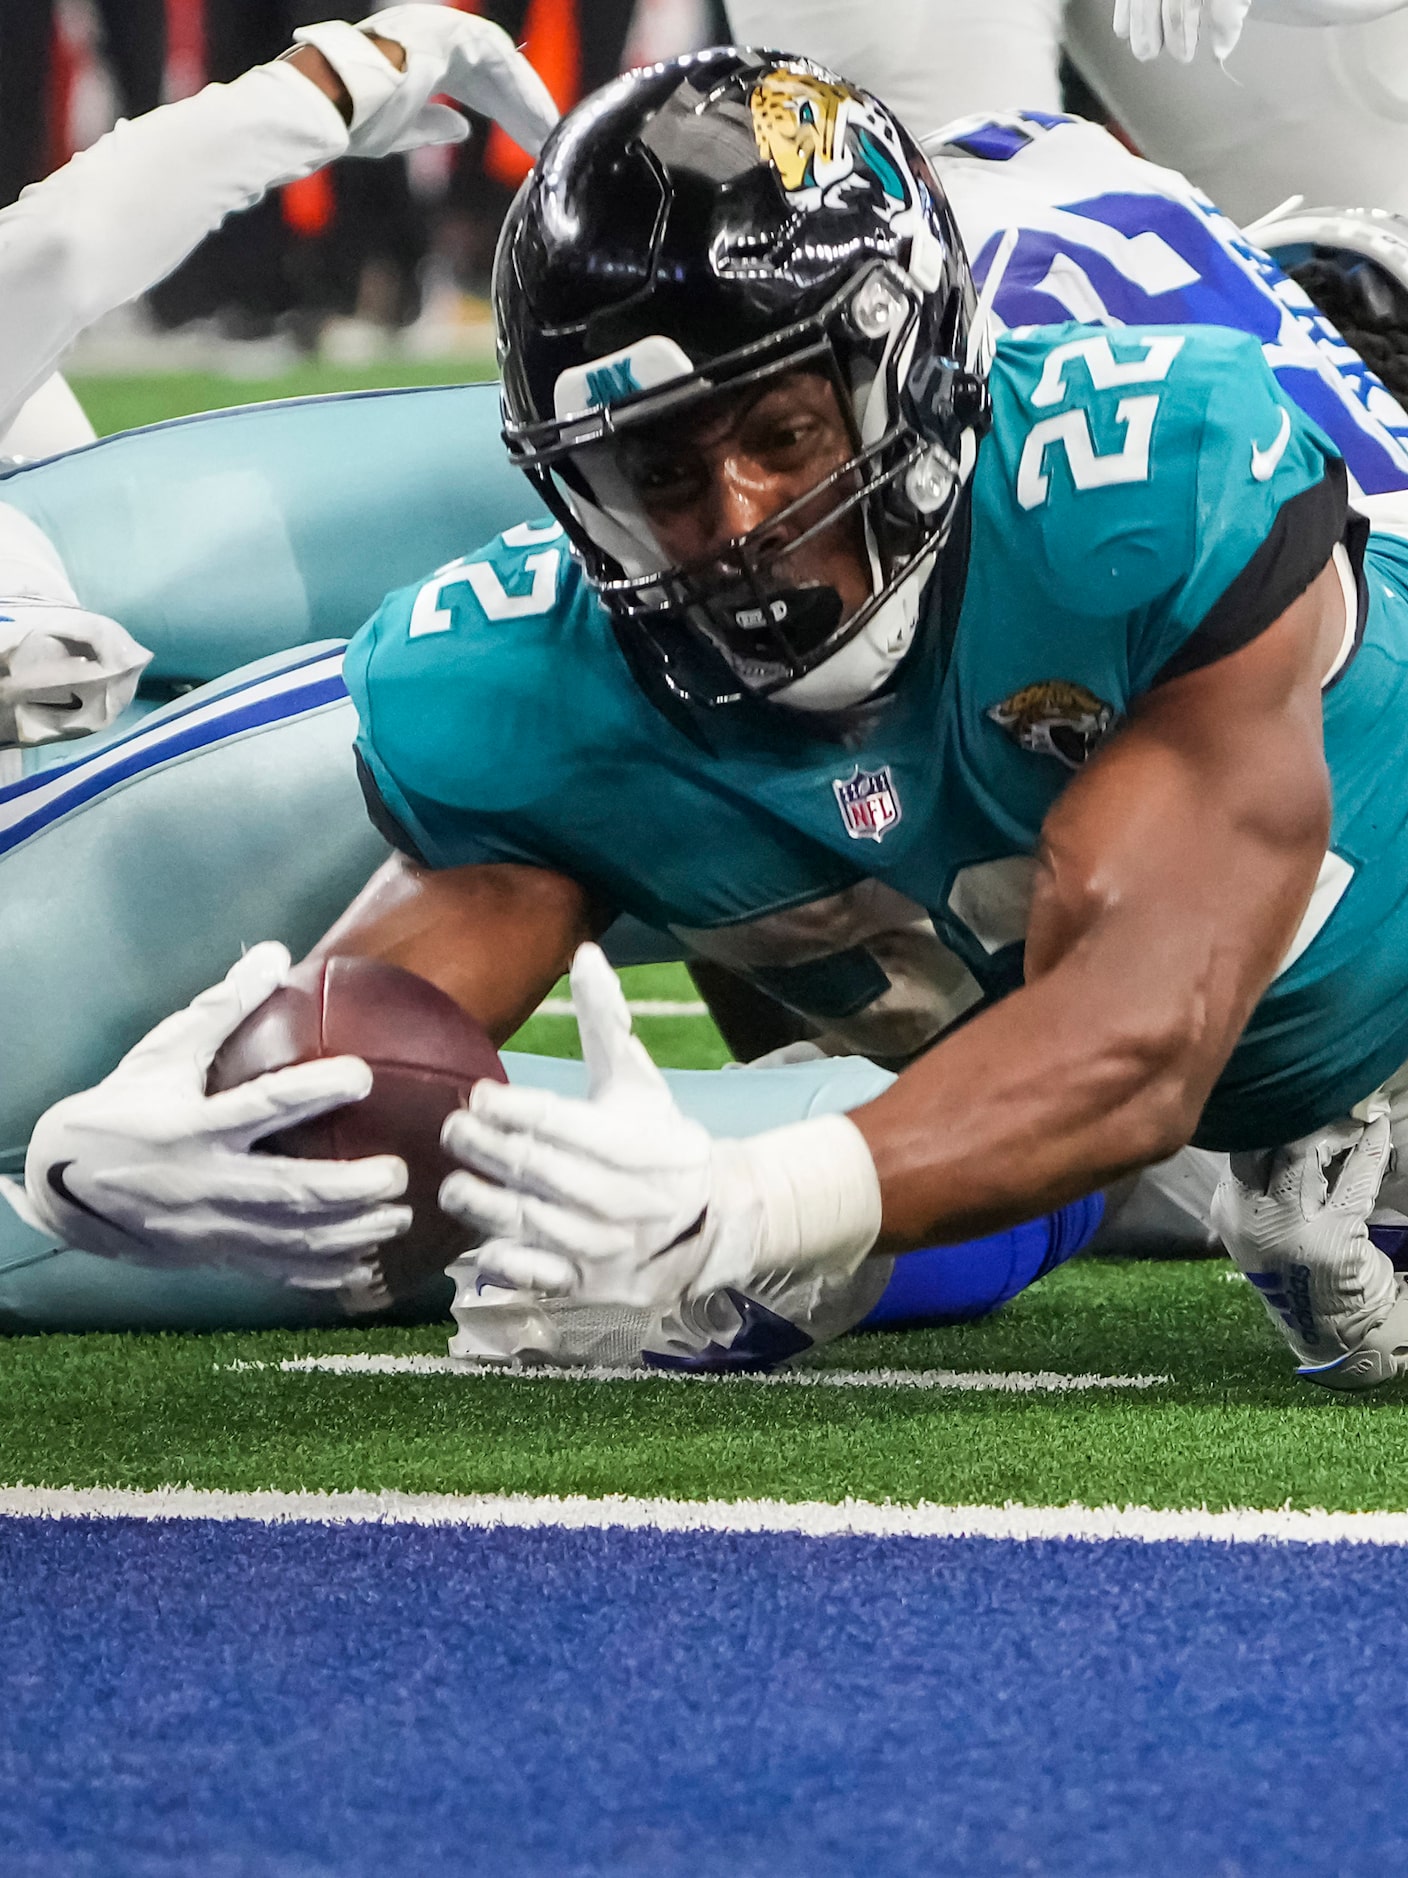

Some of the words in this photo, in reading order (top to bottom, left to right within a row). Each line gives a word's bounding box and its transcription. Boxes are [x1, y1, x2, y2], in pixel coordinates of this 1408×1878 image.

[586, 357, 641, 408] JAX
[1017, 335, 1185, 511] 22
[851, 796, 893, 827] NFL
